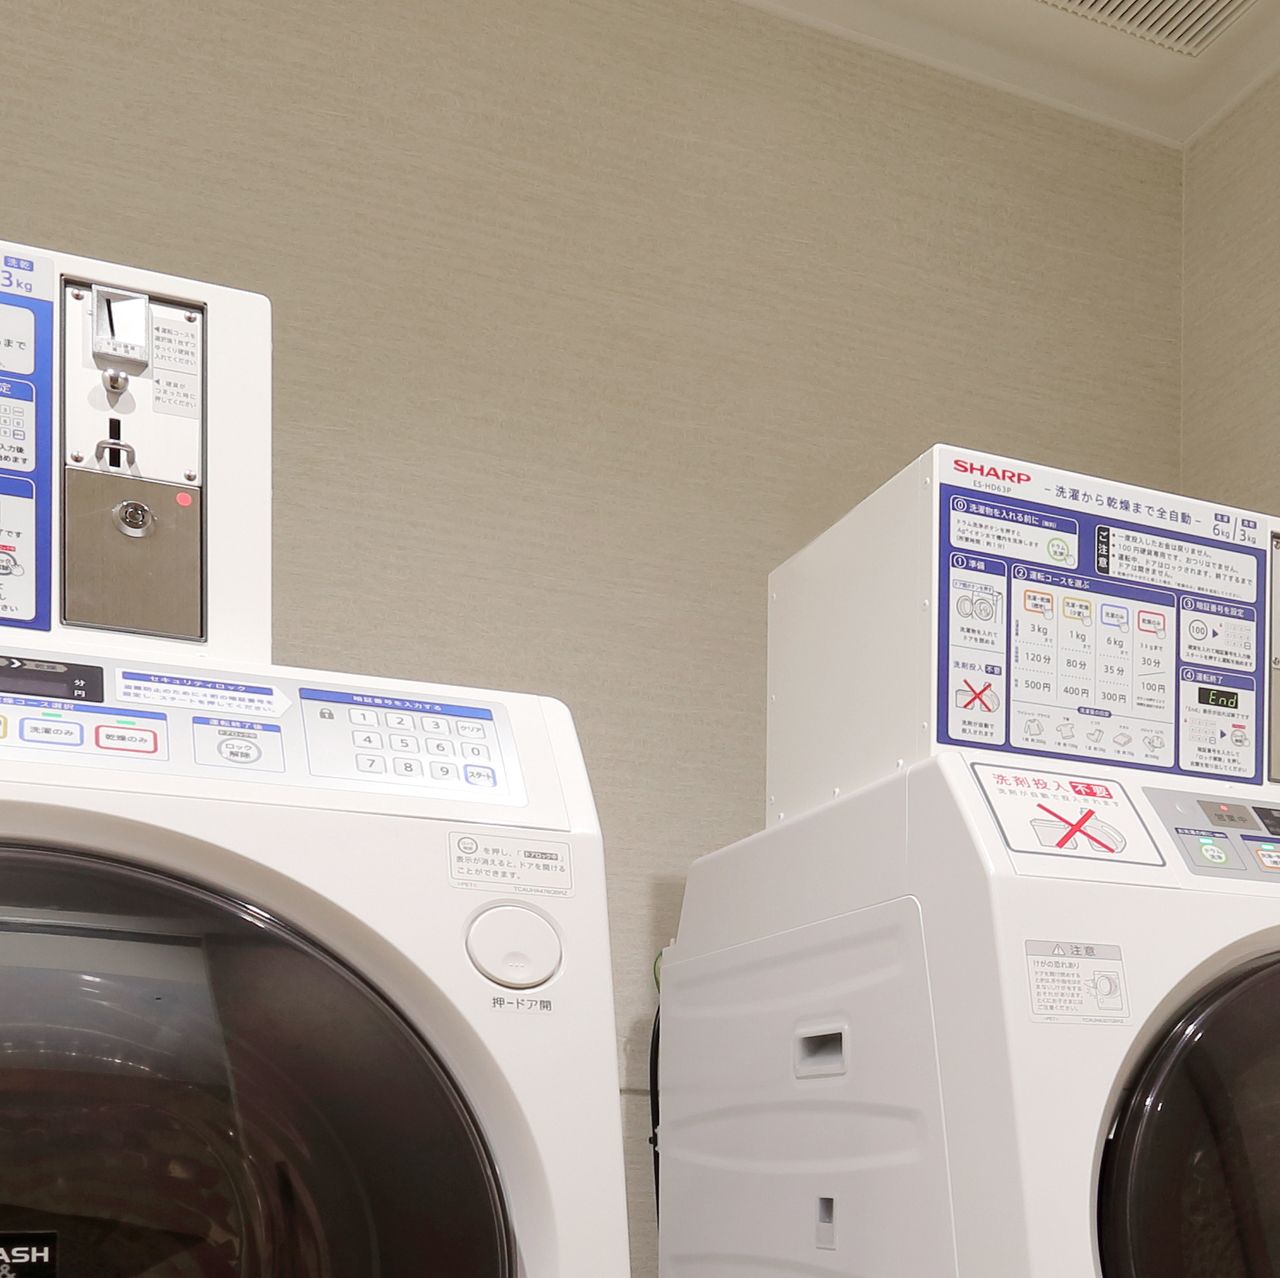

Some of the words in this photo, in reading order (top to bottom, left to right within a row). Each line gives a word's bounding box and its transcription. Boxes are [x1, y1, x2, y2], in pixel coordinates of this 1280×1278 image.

[1, 270, 33, 293] 3kg
[953, 459, 1032, 484] SHARP
[973, 480, 1012, 493] ES-HD63P
[1055, 484, 1193, 526] 洗濯から乾燥まで全自動
[74, 679, 86, 687] 分
[74, 689, 85, 698] 円
[1209, 691, 1236, 707] End
[360, 713, 367, 721] 1
[396, 717, 405, 726] 2
[432, 721, 440, 730] 3
[30, 726, 73, 737] 洗濯のみ
[105, 733, 148, 744] 乾燥のみ
[225, 743, 252, 751] ロック
[363, 736, 373, 744] 4
[400, 739, 409, 748] 5
[436, 743, 445, 752] 6
[471, 747, 481, 757] 0
[366, 758, 375, 768] 7
[404, 762, 413, 772] 8
[440, 766, 449, 776] 9
